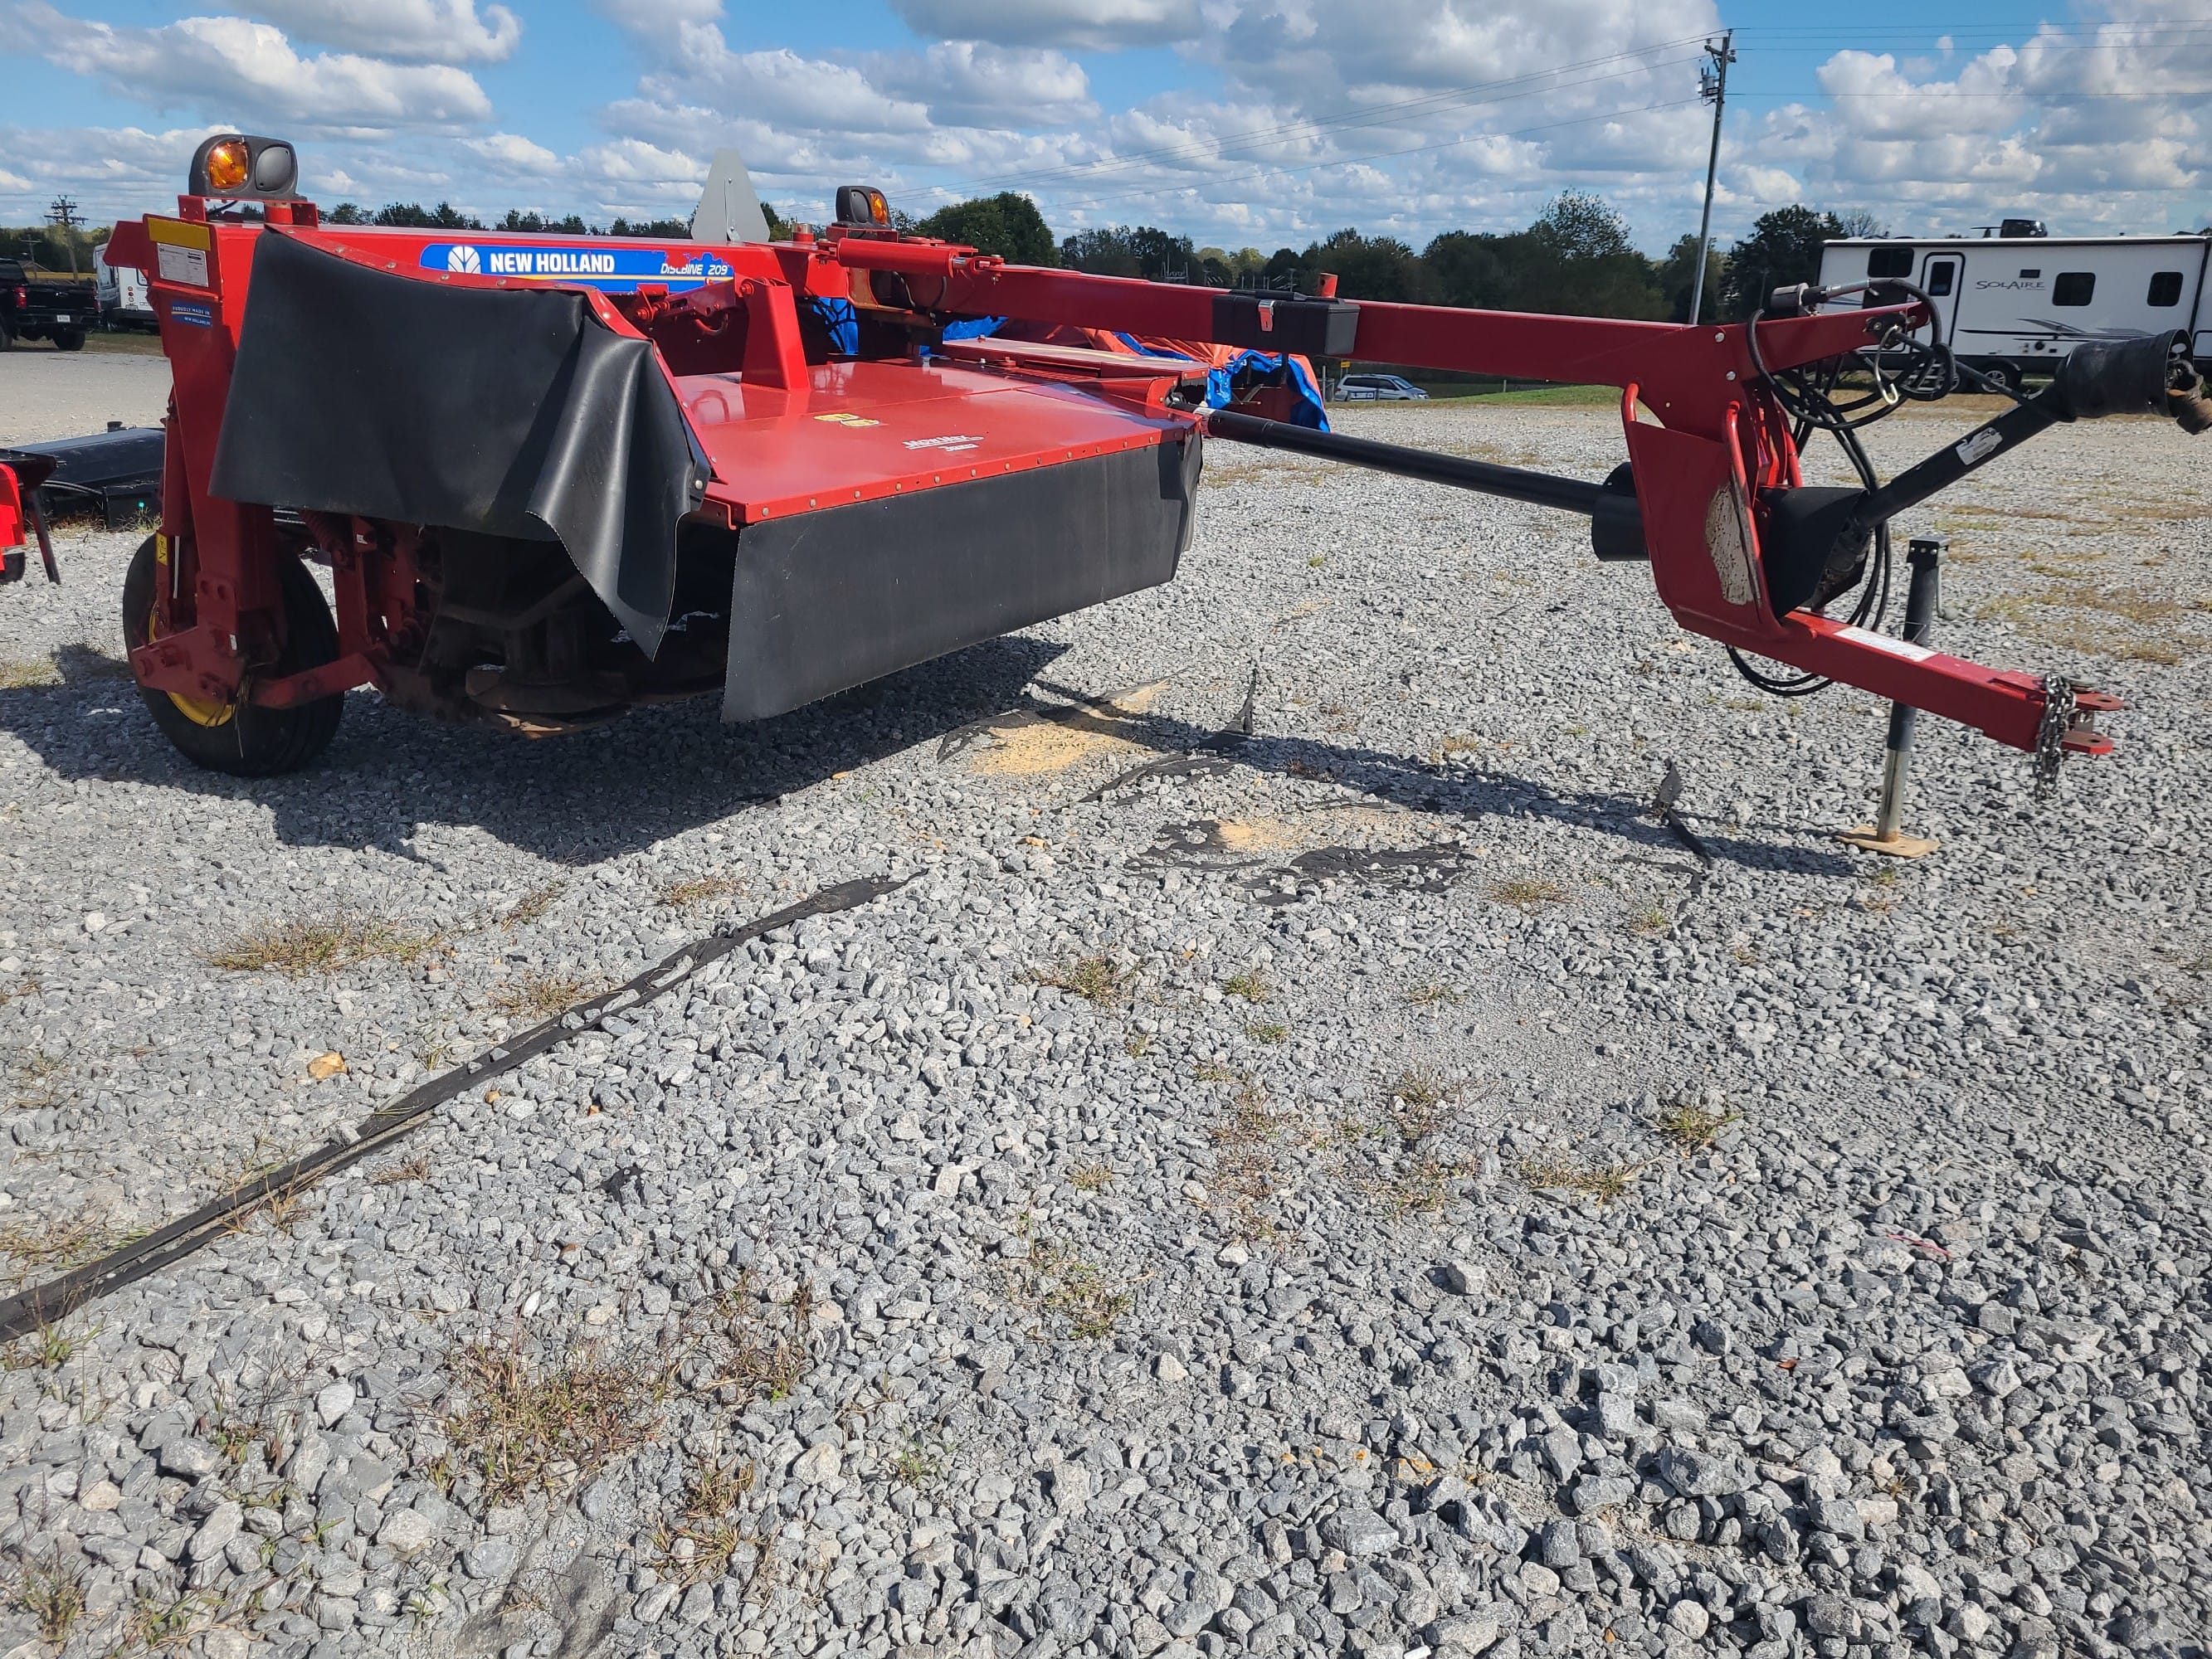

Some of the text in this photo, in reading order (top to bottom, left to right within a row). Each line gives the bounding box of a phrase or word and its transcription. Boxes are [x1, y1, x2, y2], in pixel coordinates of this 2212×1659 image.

[490, 253, 615, 273] NEW HOLLAND
[708, 264, 728, 275] 209
